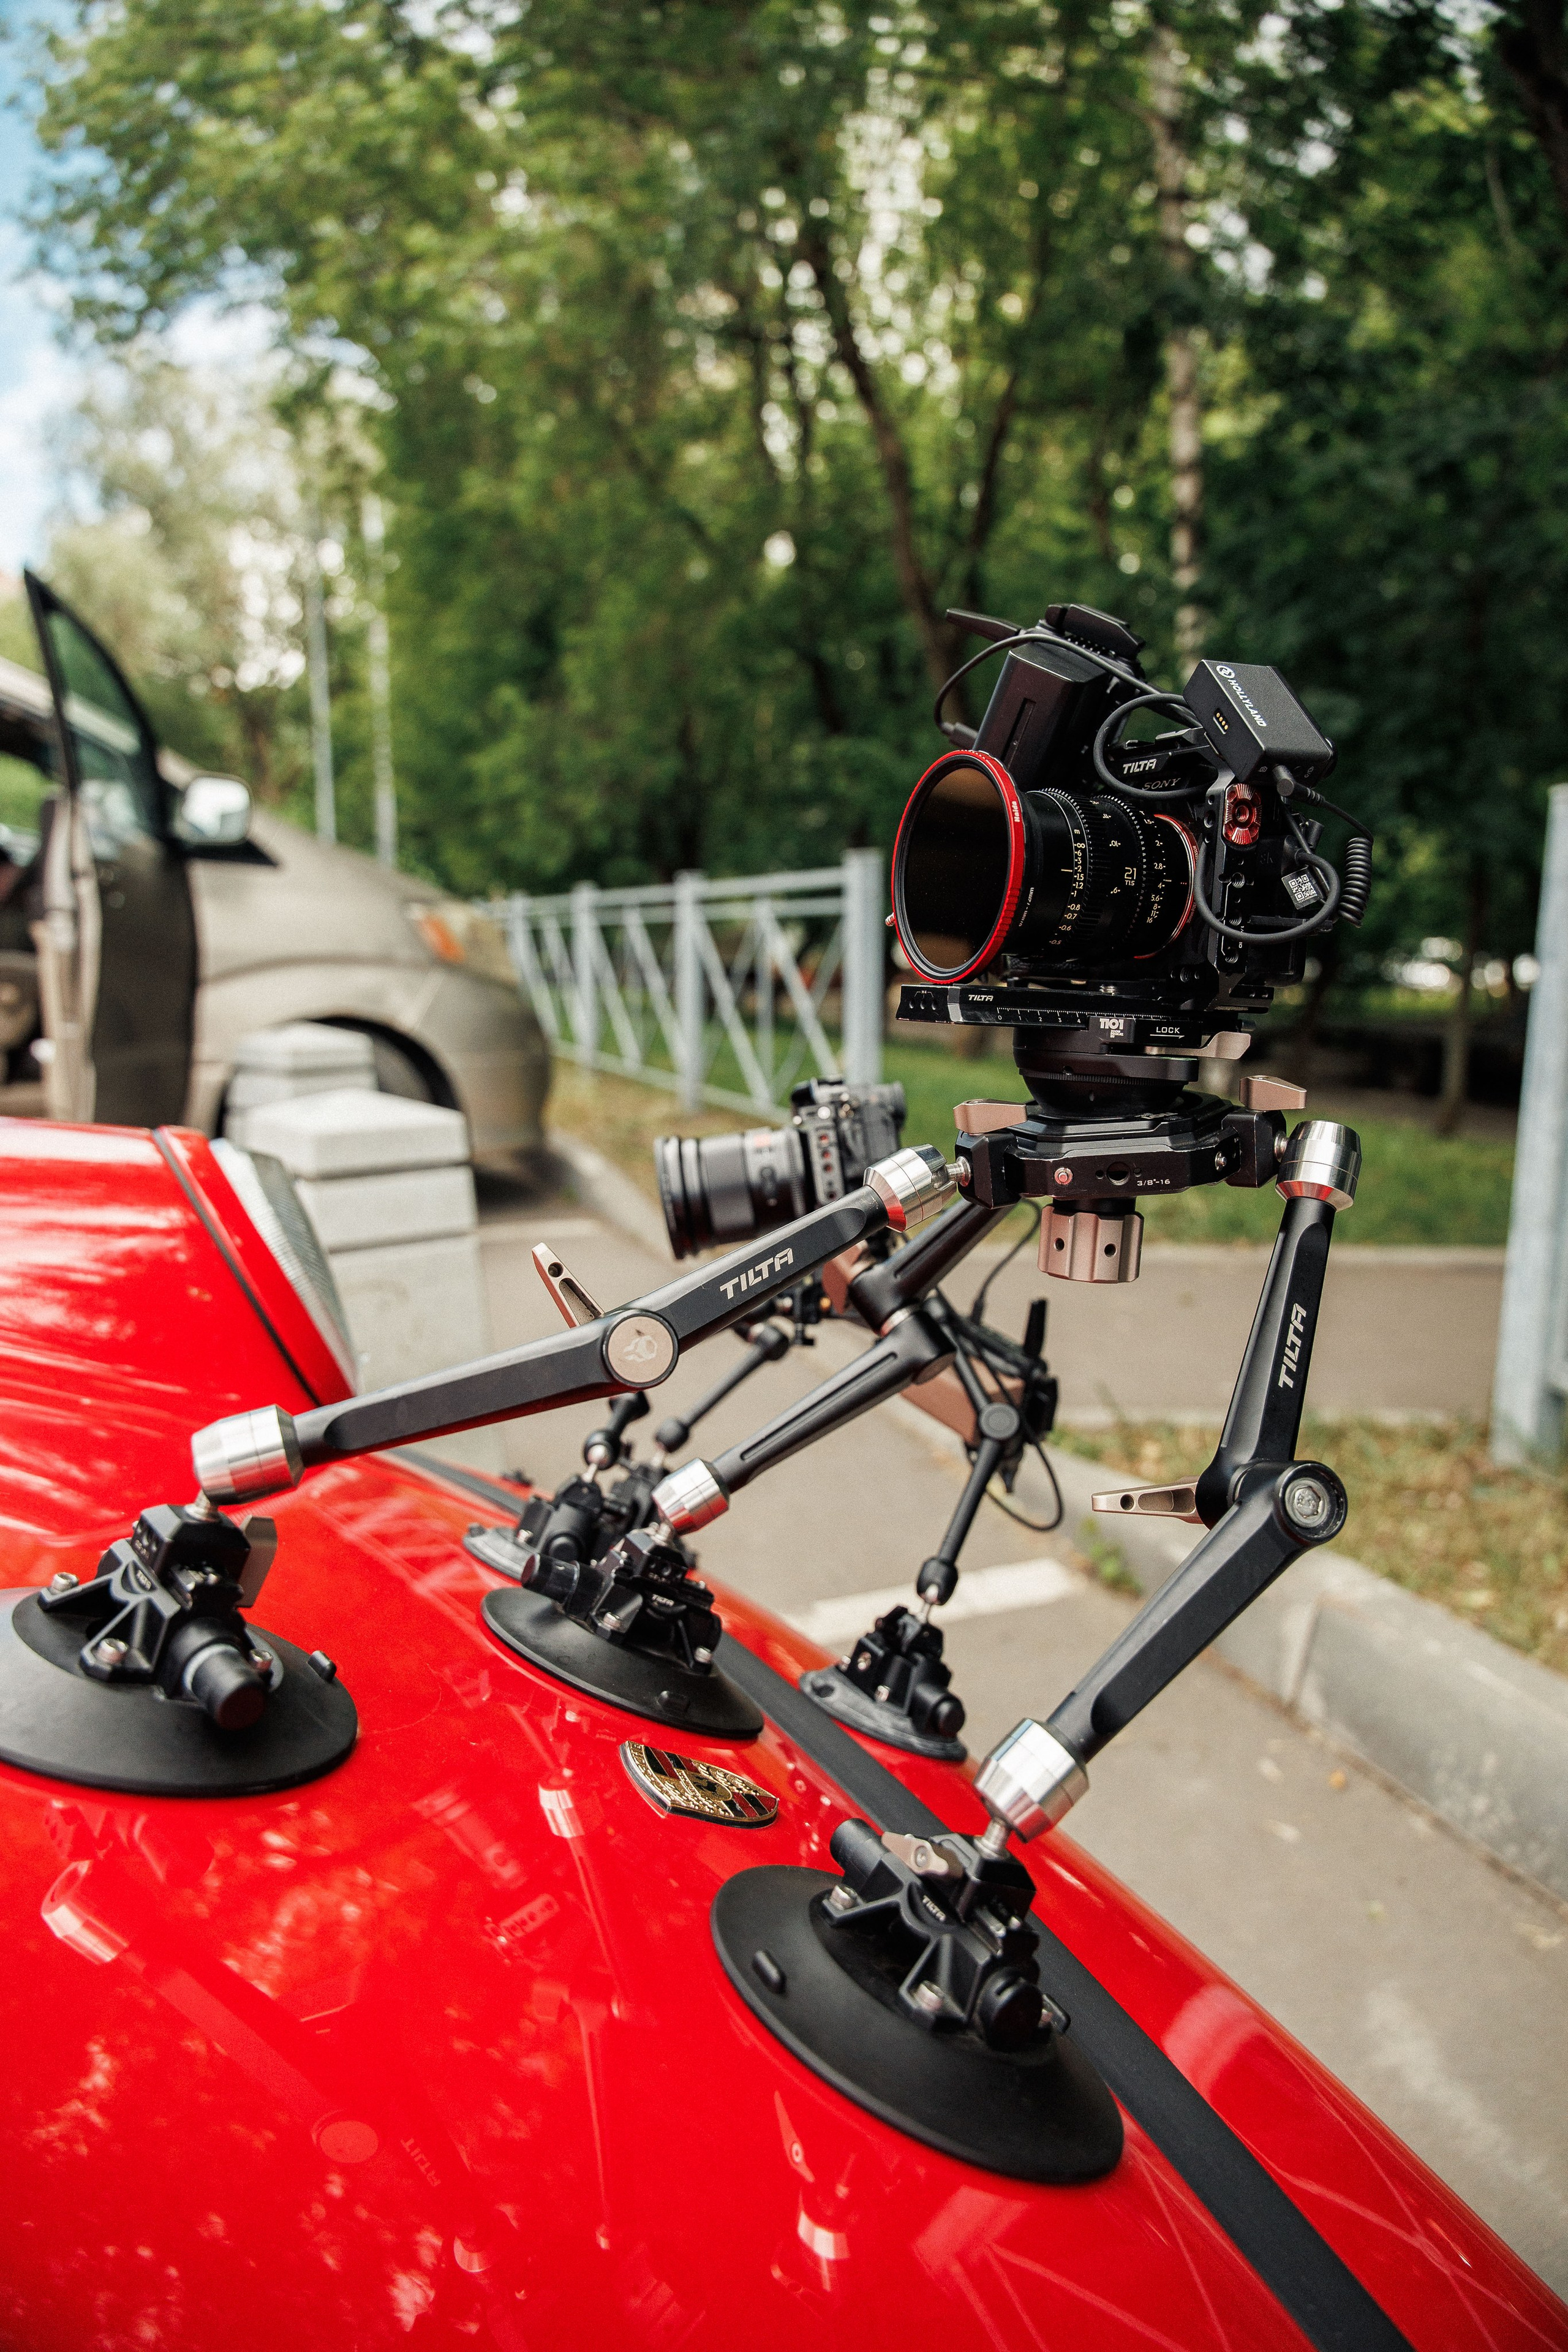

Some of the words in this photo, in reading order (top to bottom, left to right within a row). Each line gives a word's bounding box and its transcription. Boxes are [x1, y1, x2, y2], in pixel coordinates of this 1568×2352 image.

[1228, 679, 1267, 727] HOLLYLAND
[1123, 759, 1157, 774] TILTA
[1142, 778, 1182, 791] SONY
[1125, 867, 1136, 880] 21
[720, 1248, 794, 1299] TILTA
[1278, 1303, 1306, 1388] TILTA
